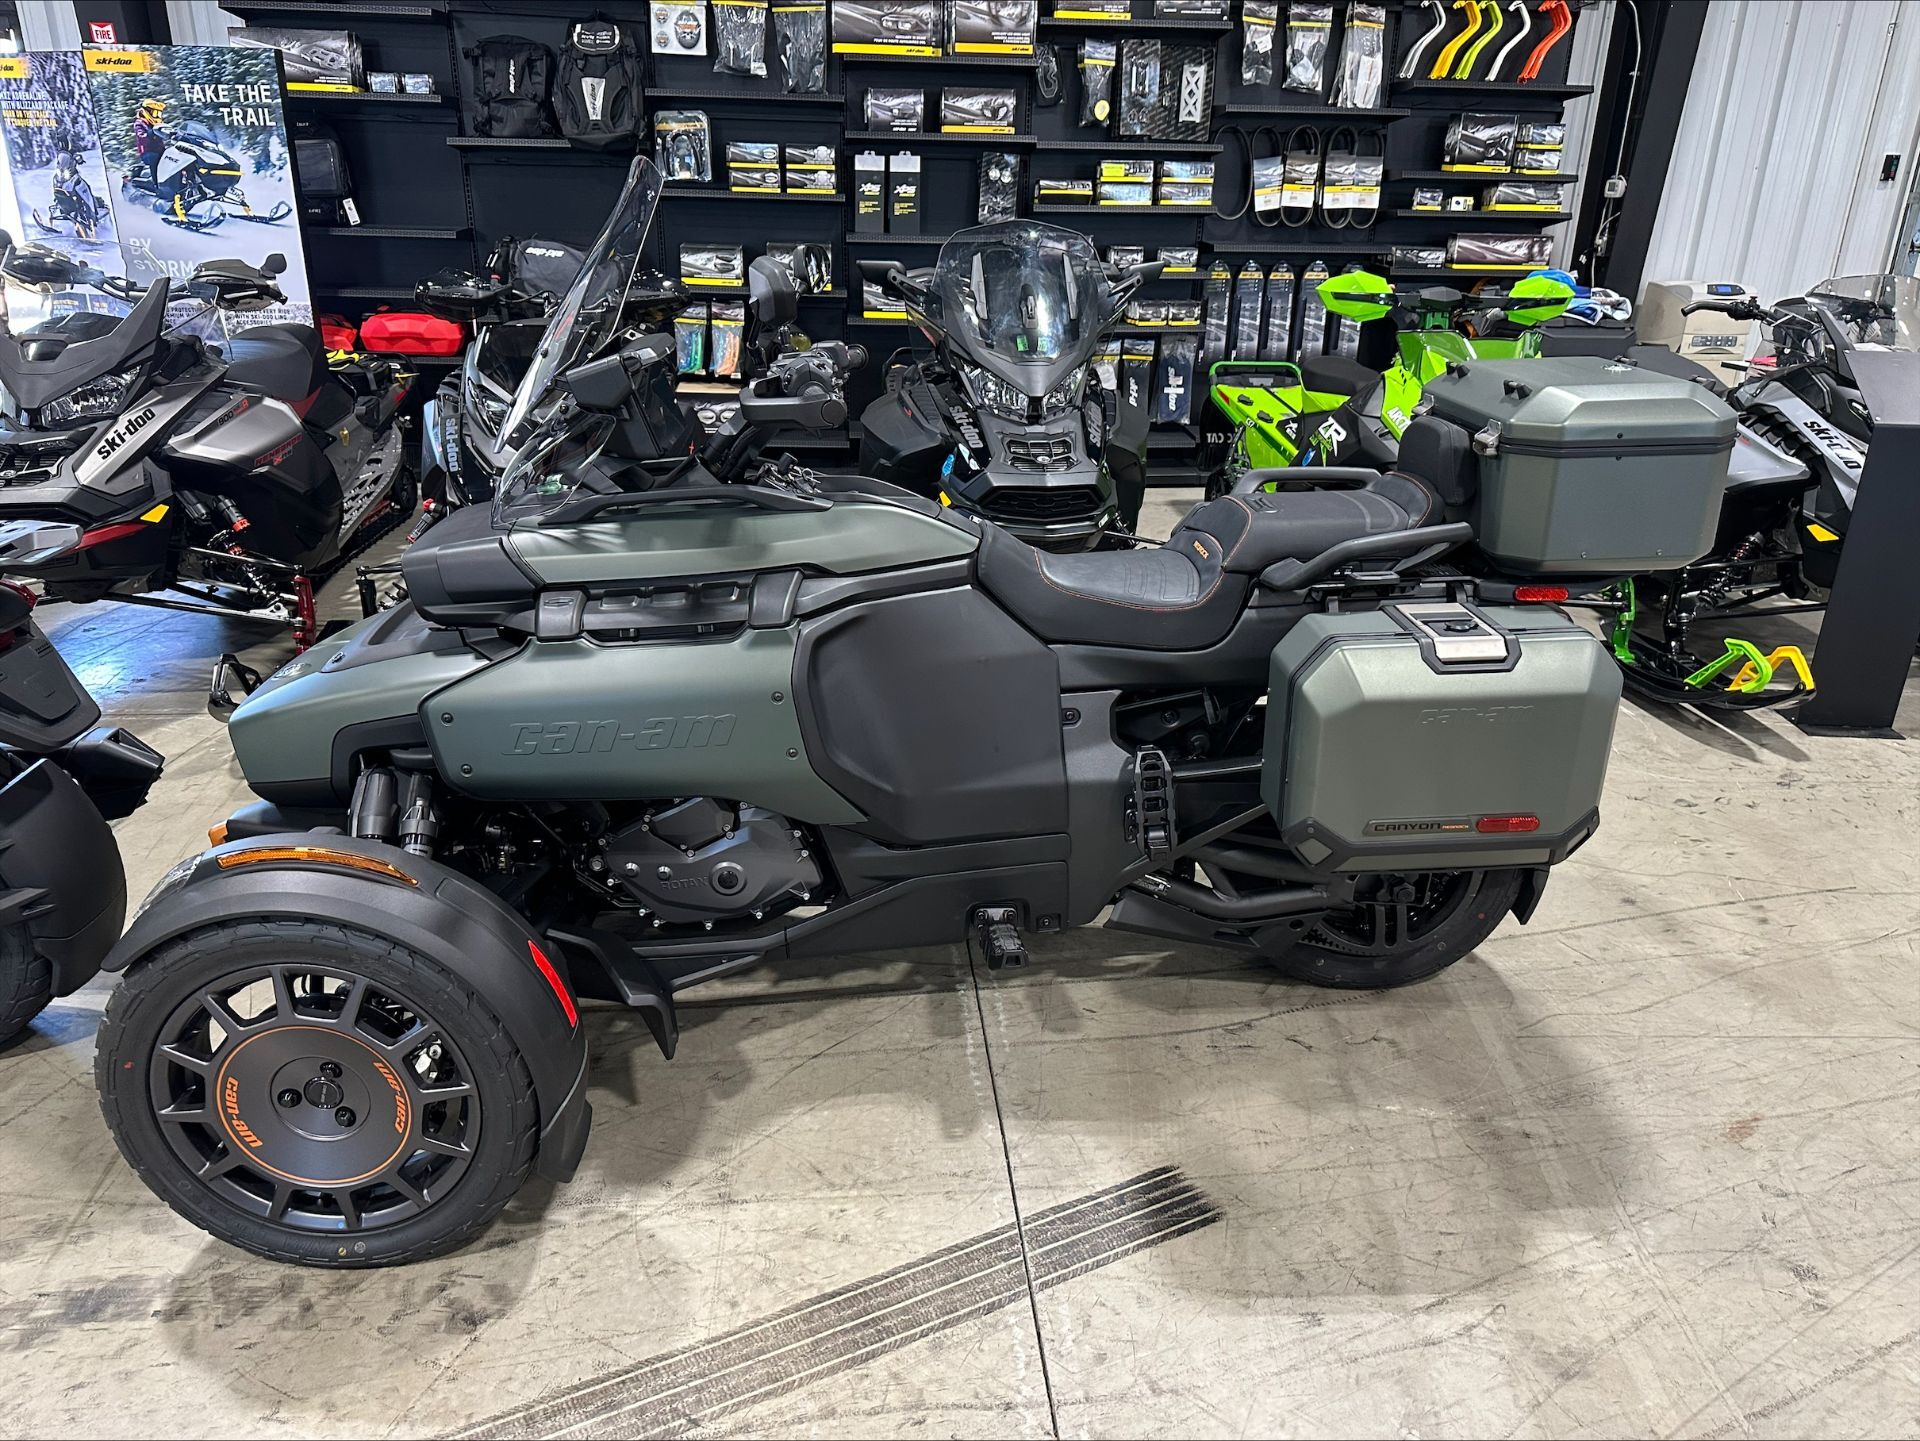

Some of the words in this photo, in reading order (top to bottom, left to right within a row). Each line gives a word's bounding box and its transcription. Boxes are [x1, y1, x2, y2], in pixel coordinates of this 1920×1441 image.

[95, 29, 112, 41] FIRE
[0, 64, 14, 72] i-doo
[95, 57, 133, 65] ski-doo
[180, 84, 229, 103] TAKE
[235, 84, 272, 103] THE
[219, 108, 276, 126] TRAIL
[129, 238, 151, 255] BY
[133, 259, 194, 277] STORM
[97, 407, 156, 460] ski-doo
[949, 405, 984, 448] ski-doo
[446, 418, 458, 472] ski-doo
[501, 713, 737, 756] can-am
[1374, 822, 1441, 832] CANYON
[372, 1061, 406, 1134] can-am
[225, 1076, 263, 1149] can-am
